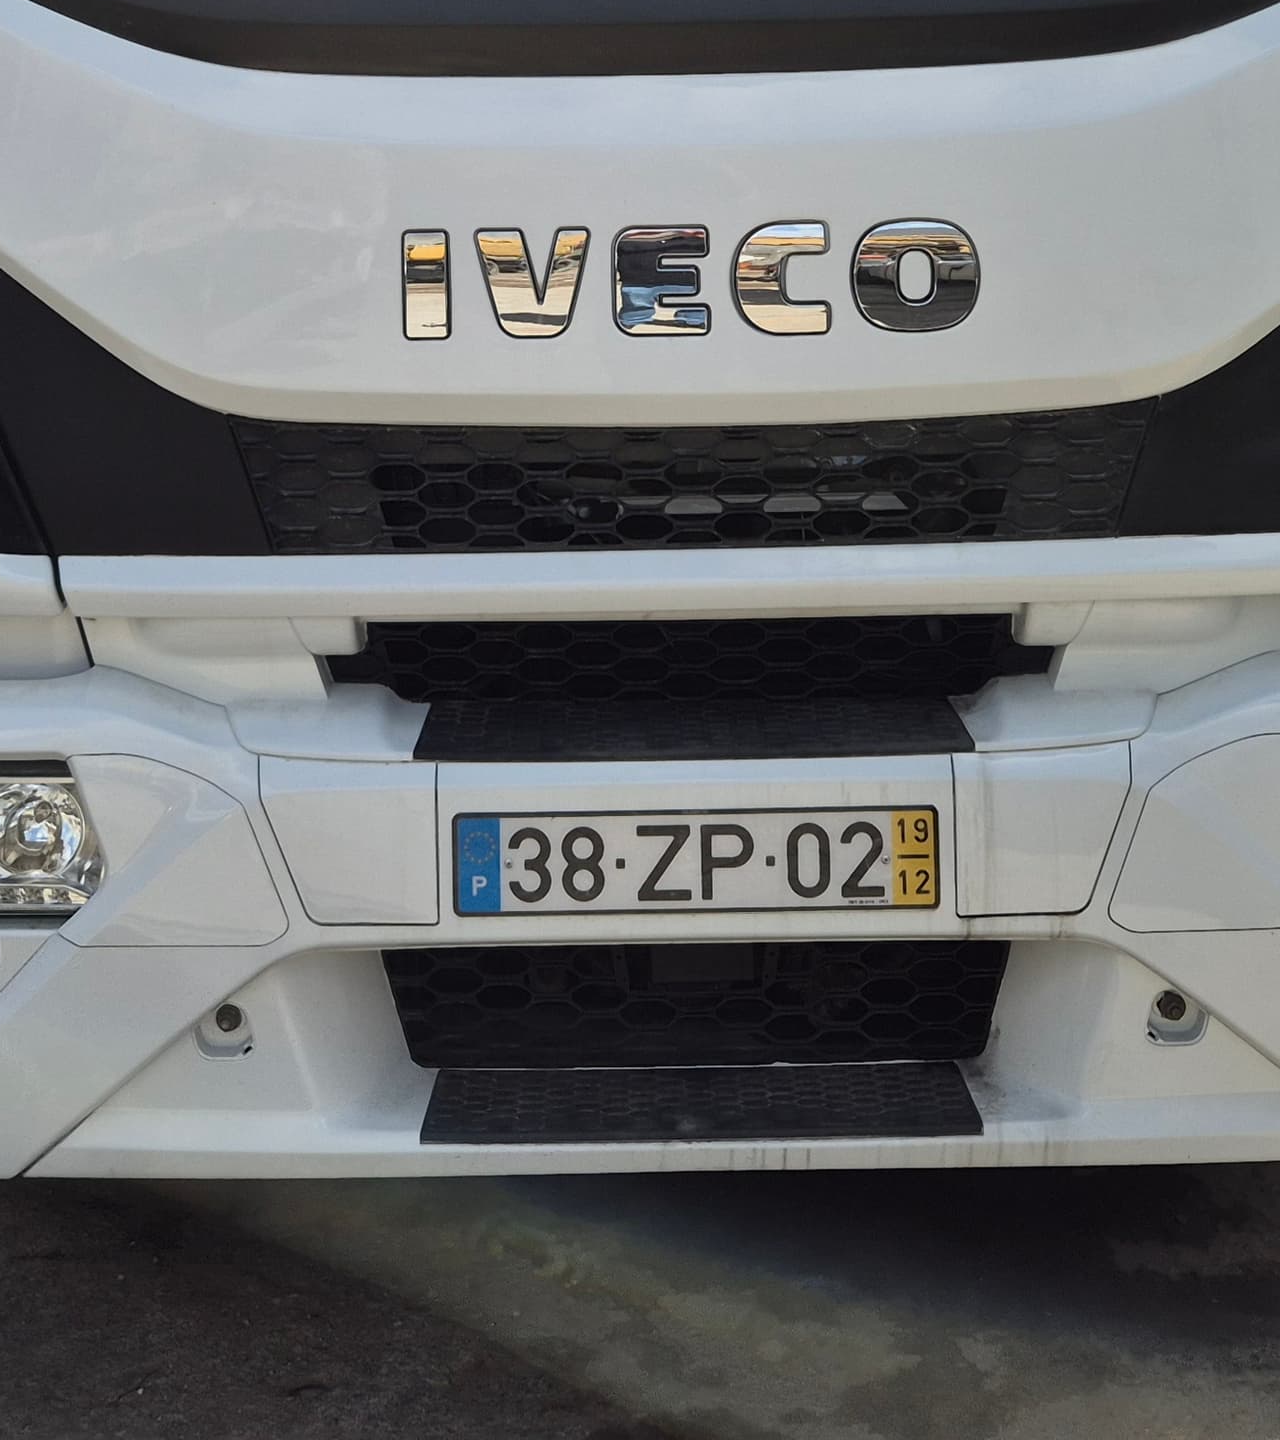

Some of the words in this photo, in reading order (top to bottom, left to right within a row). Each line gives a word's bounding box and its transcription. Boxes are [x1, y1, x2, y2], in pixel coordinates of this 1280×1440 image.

[400, 217, 982, 340] IVECO
[897, 818, 929, 844] 19
[472, 876, 487, 896] P
[898, 869, 931, 895] 12
